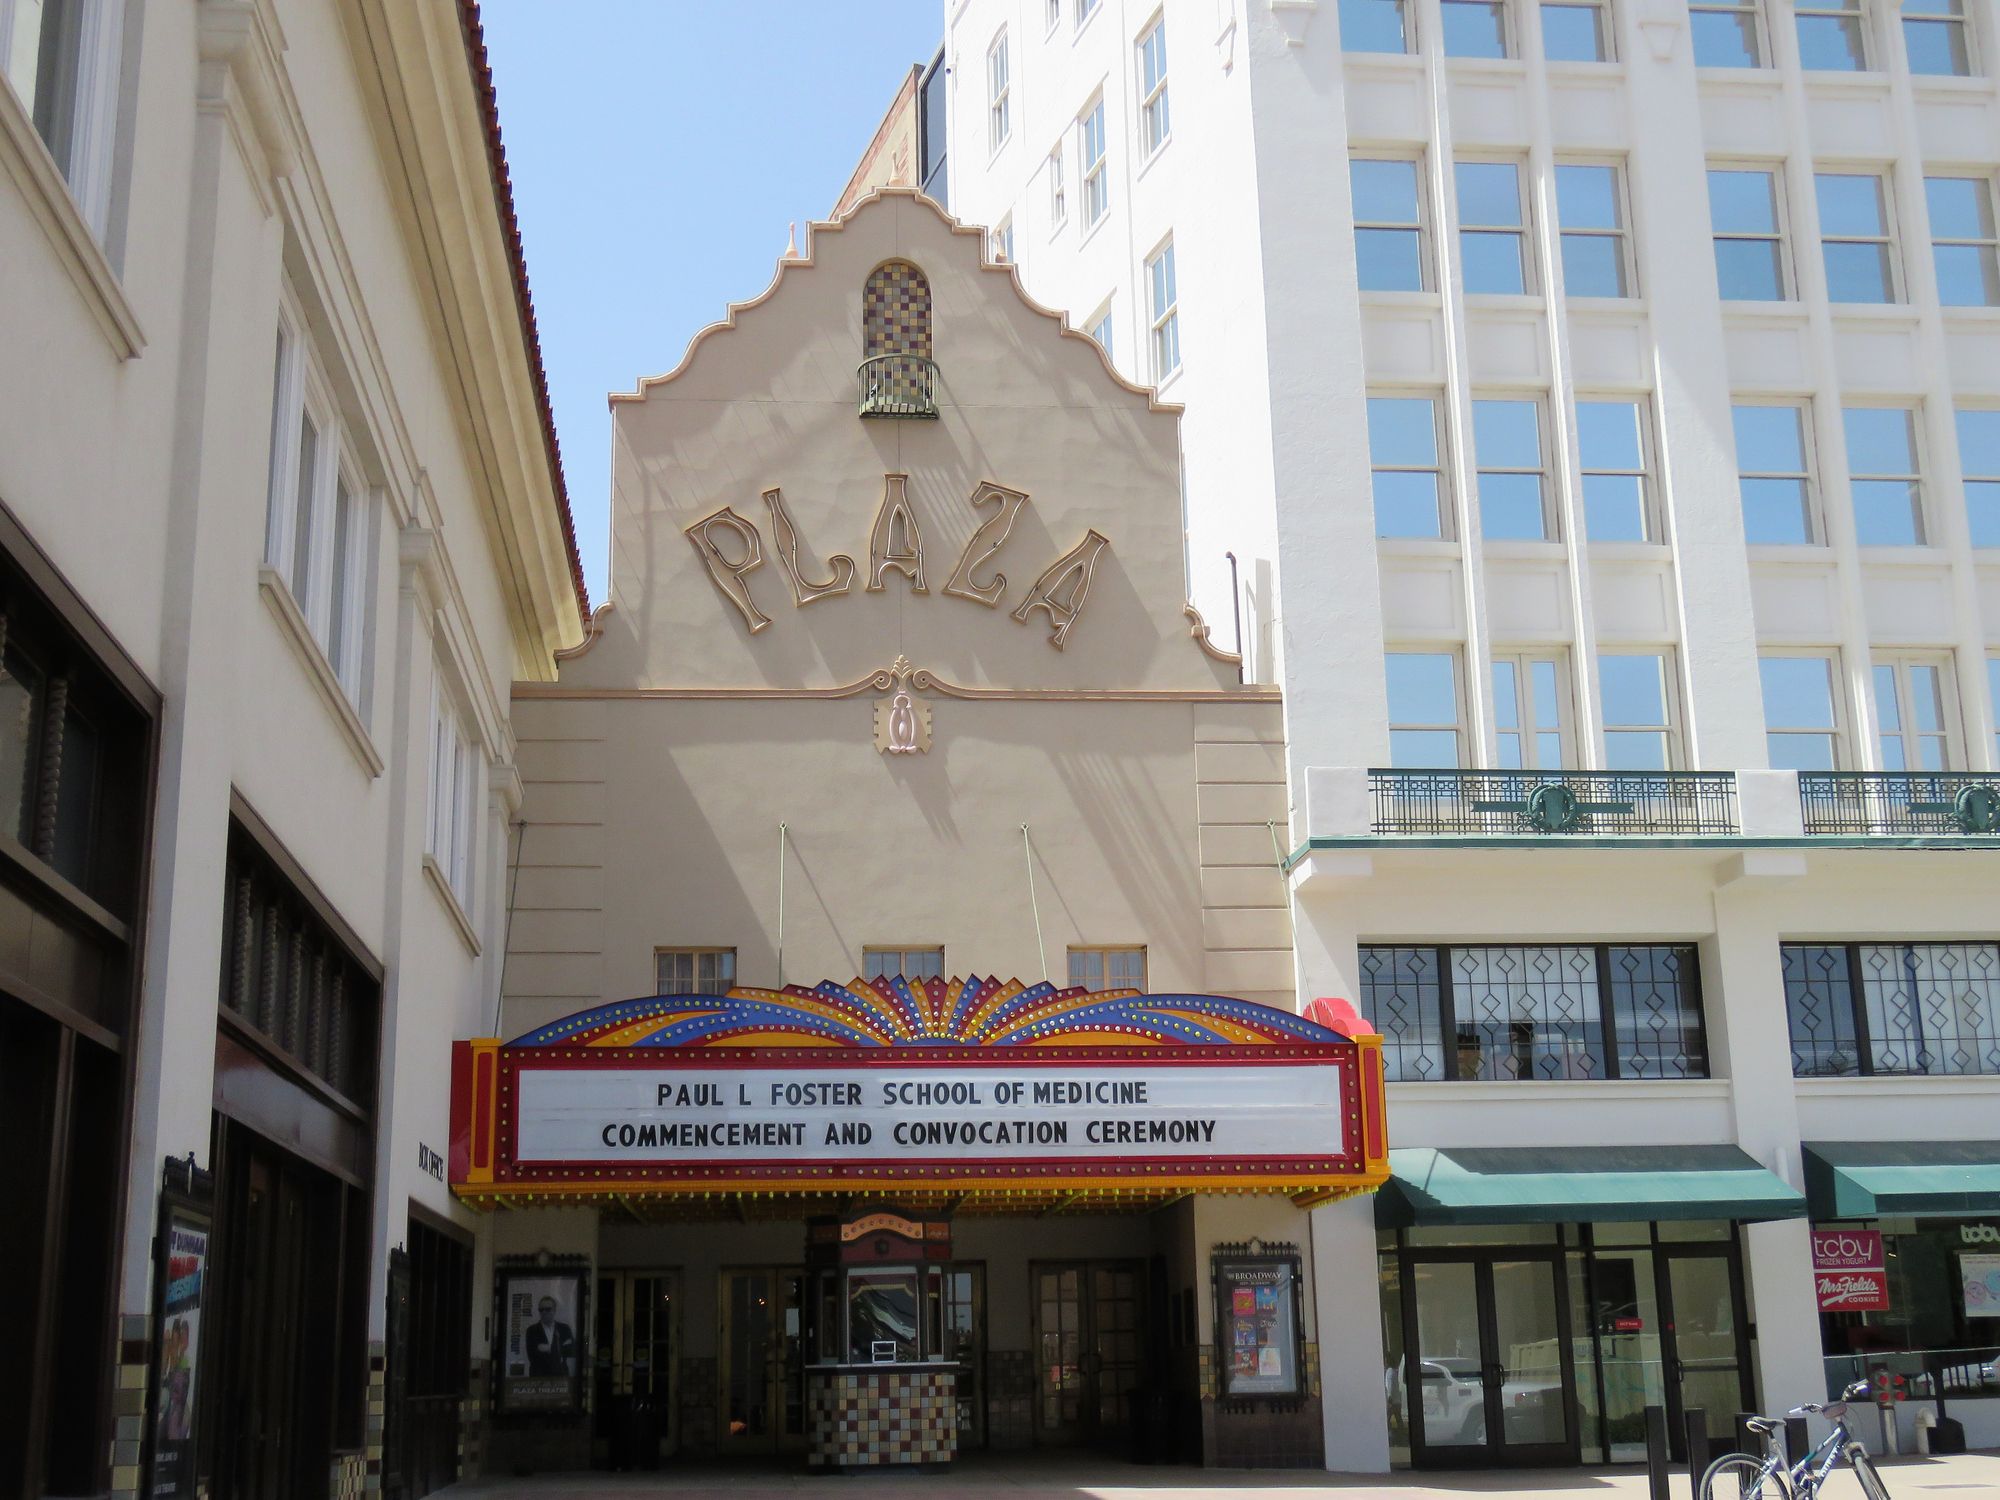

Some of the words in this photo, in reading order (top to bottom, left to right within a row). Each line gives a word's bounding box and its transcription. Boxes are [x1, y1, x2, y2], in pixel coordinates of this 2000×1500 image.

[684, 473, 1110, 652] PLAZA
[657, 1083, 724, 1106] PAUL
[739, 1083, 752, 1106] L
[771, 1083, 863, 1106] FOSTER
[882, 1082, 982, 1105] SCHOOL
[994, 1081, 1025, 1105] OF
[1033, 1081, 1148, 1105] MEDICINE
[601, 1123, 807, 1147] COMMENCEMENT
[824, 1122, 872, 1146] AND
[893, 1121, 1068, 1145] CONVOCATION
[1085, 1120, 1216, 1144] CEREMONY
[419, 1141, 429, 1172] BOX
[429, 1150, 444, 1183] OFFICE
[1814, 1234, 1873, 1261] tcby
[1816, 1257, 1841, 1265] FROZEN
[1842, 1256, 1868, 1265] YOGURT
[1234, 1271, 1283, 1281] BROADWAY
